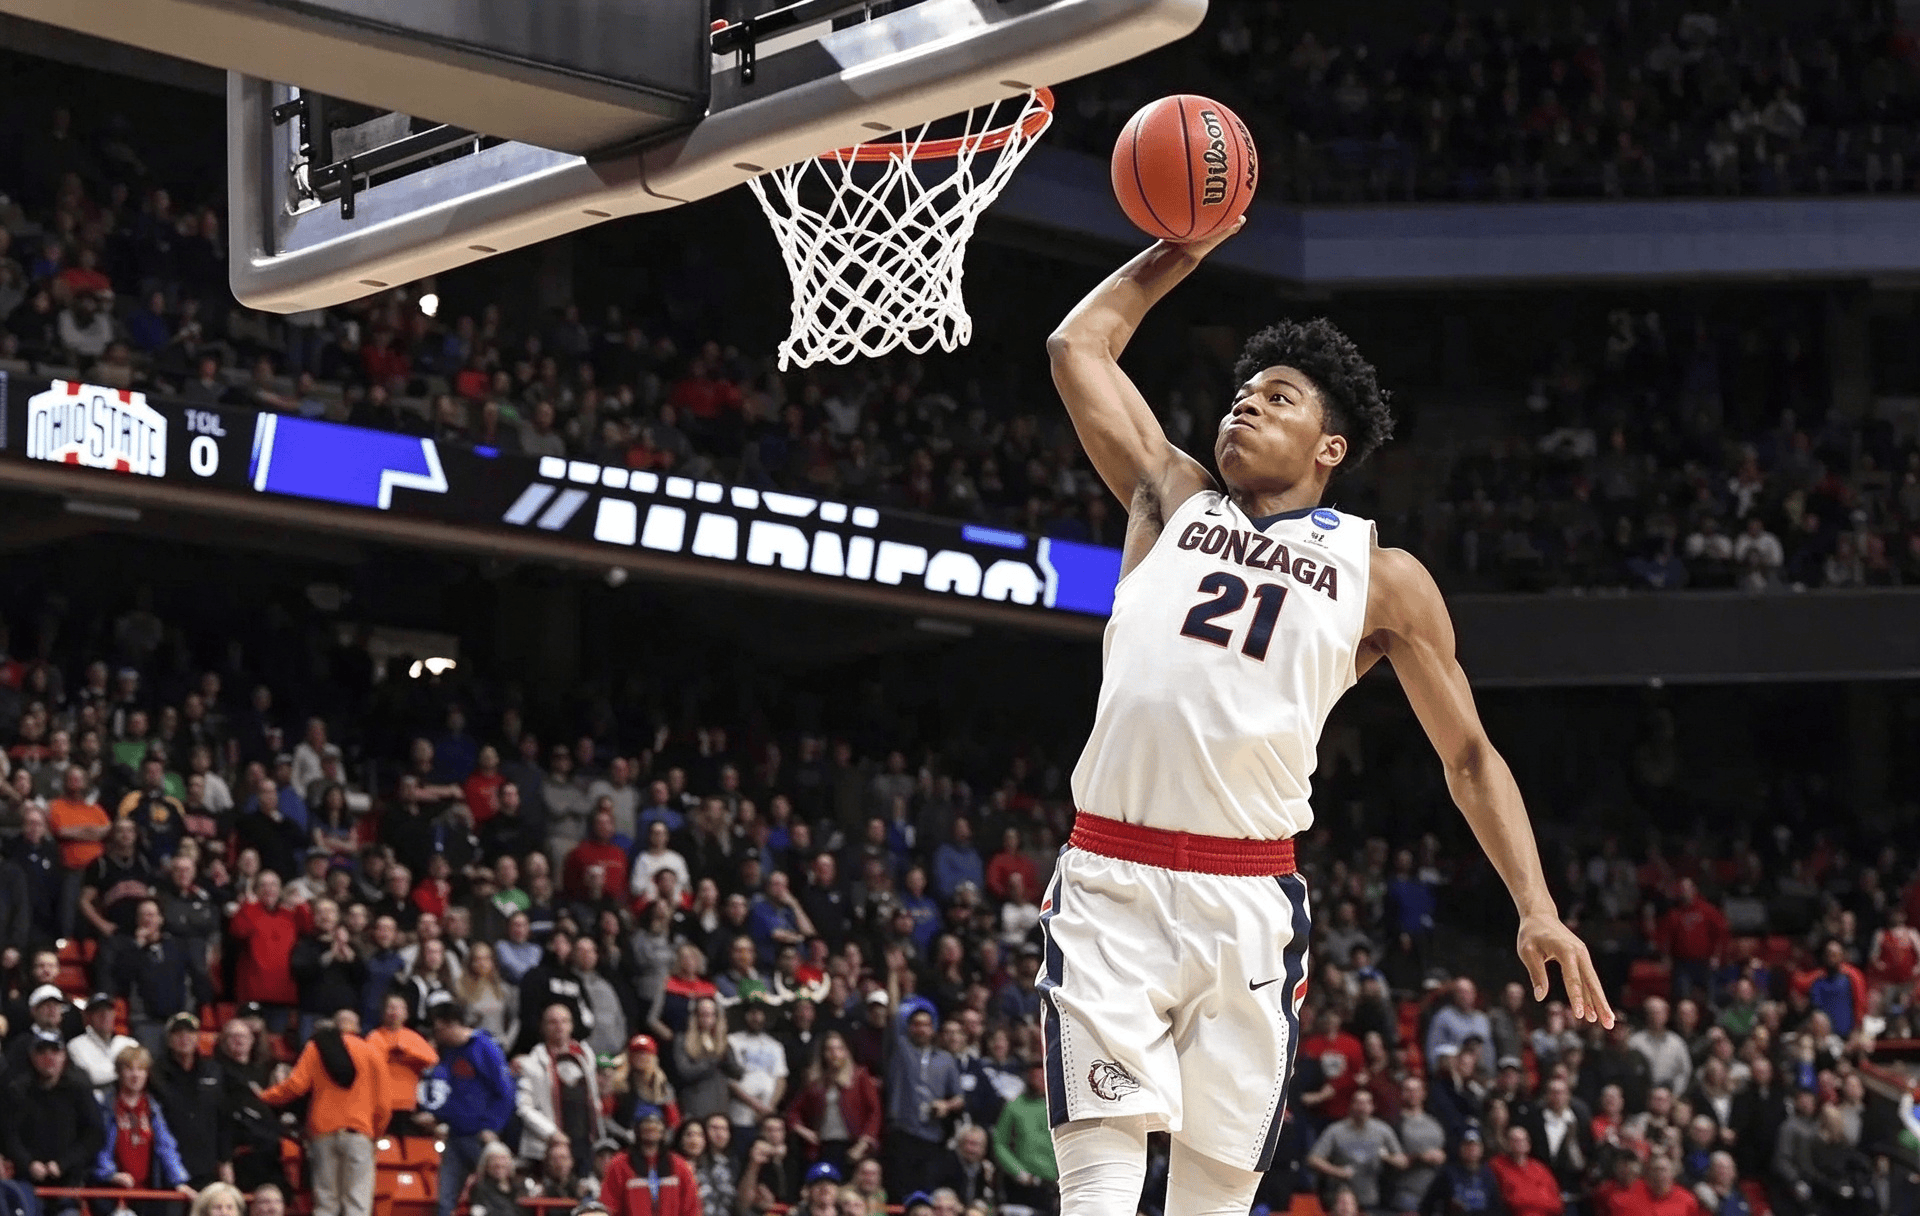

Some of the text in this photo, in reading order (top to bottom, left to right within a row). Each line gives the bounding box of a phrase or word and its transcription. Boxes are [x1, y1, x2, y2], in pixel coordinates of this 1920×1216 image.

[1201, 110, 1228, 206] Wilson
[184, 408, 227, 437] TOL
[190, 435, 219, 477] 0
[1177, 521, 1338, 602] GONZAGA
[1179, 571, 1289, 663] 21
